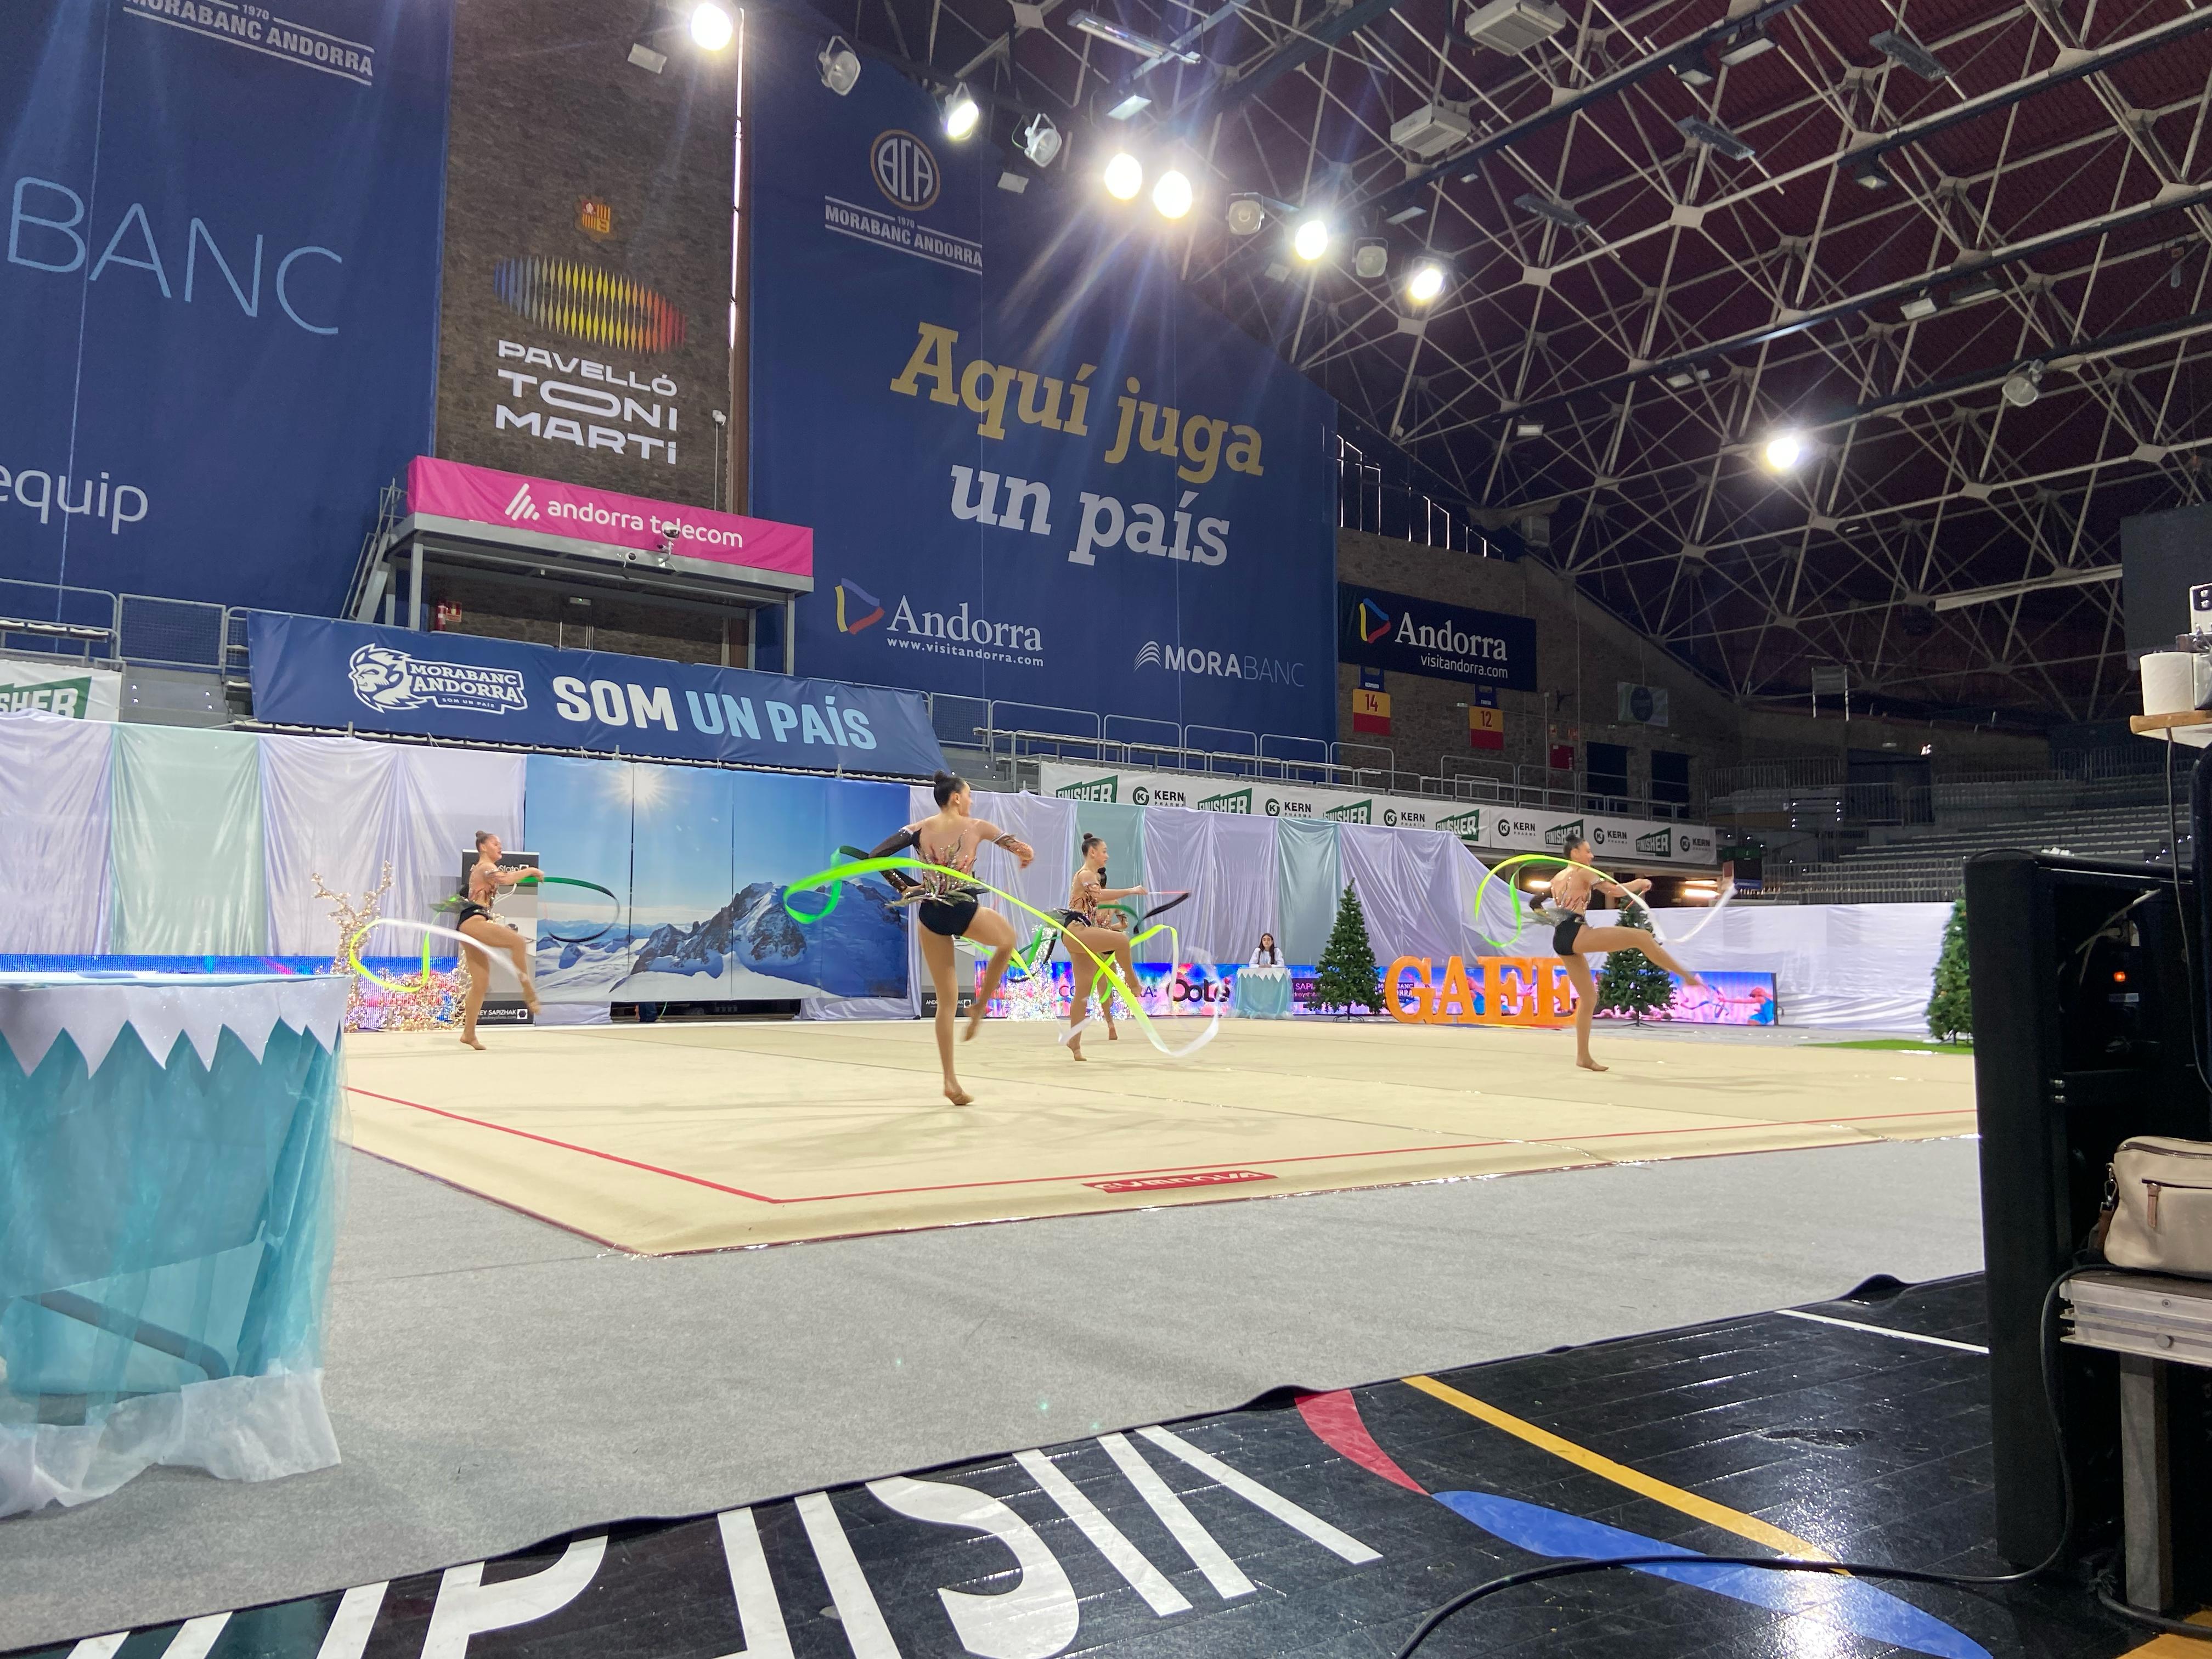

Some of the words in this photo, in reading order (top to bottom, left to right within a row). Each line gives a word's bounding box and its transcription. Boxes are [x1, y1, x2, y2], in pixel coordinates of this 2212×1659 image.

[242, 4, 269, 20] 1970
[266, 27, 373, 76] ANDORRA
[825, 205, 911, 245] MORABANC
[913, 234, 983, 268] ANDORRA
[8, 176, 342, 334] BANC
[498, 338, 678, 397] PAVELLÓ
[498, 369, 678, 431] TONI
[890, 321, 1097, 440] Aquí
[1104, 377, 1264, 483] juga
[548, 500, 644, 531] andorra
[951, 465, 1052, 535] un
[1068, 490, 1230, 566] país
[886, 595, 1043, 652] Andorra
[1394, 612, 1508, 661] Andorra
[887, 637, 1044, 667] www.visitandorra.com
[1420, 652, 1508, 679] visitandorra.com
[410, 663, 518, 685] MORABANC
[413, 676, 521, 703] ANDORRA
[1365, 693, 1378, 712] 14
[553, 675, 679, 731] SOM
[685, 690, 761, 740] UN
[765, 695, 877, 750] PAÍS
[1480, 710, 1492, 727] 12
[1154, 790, 1184, 802] KERN
[1284, 802, 1311, 812] KERN
[1401, 812, 1425, 822] KERN
[1514, 822, 1536, 831] KERN
[1607, 830, 1627, 839] KERN
